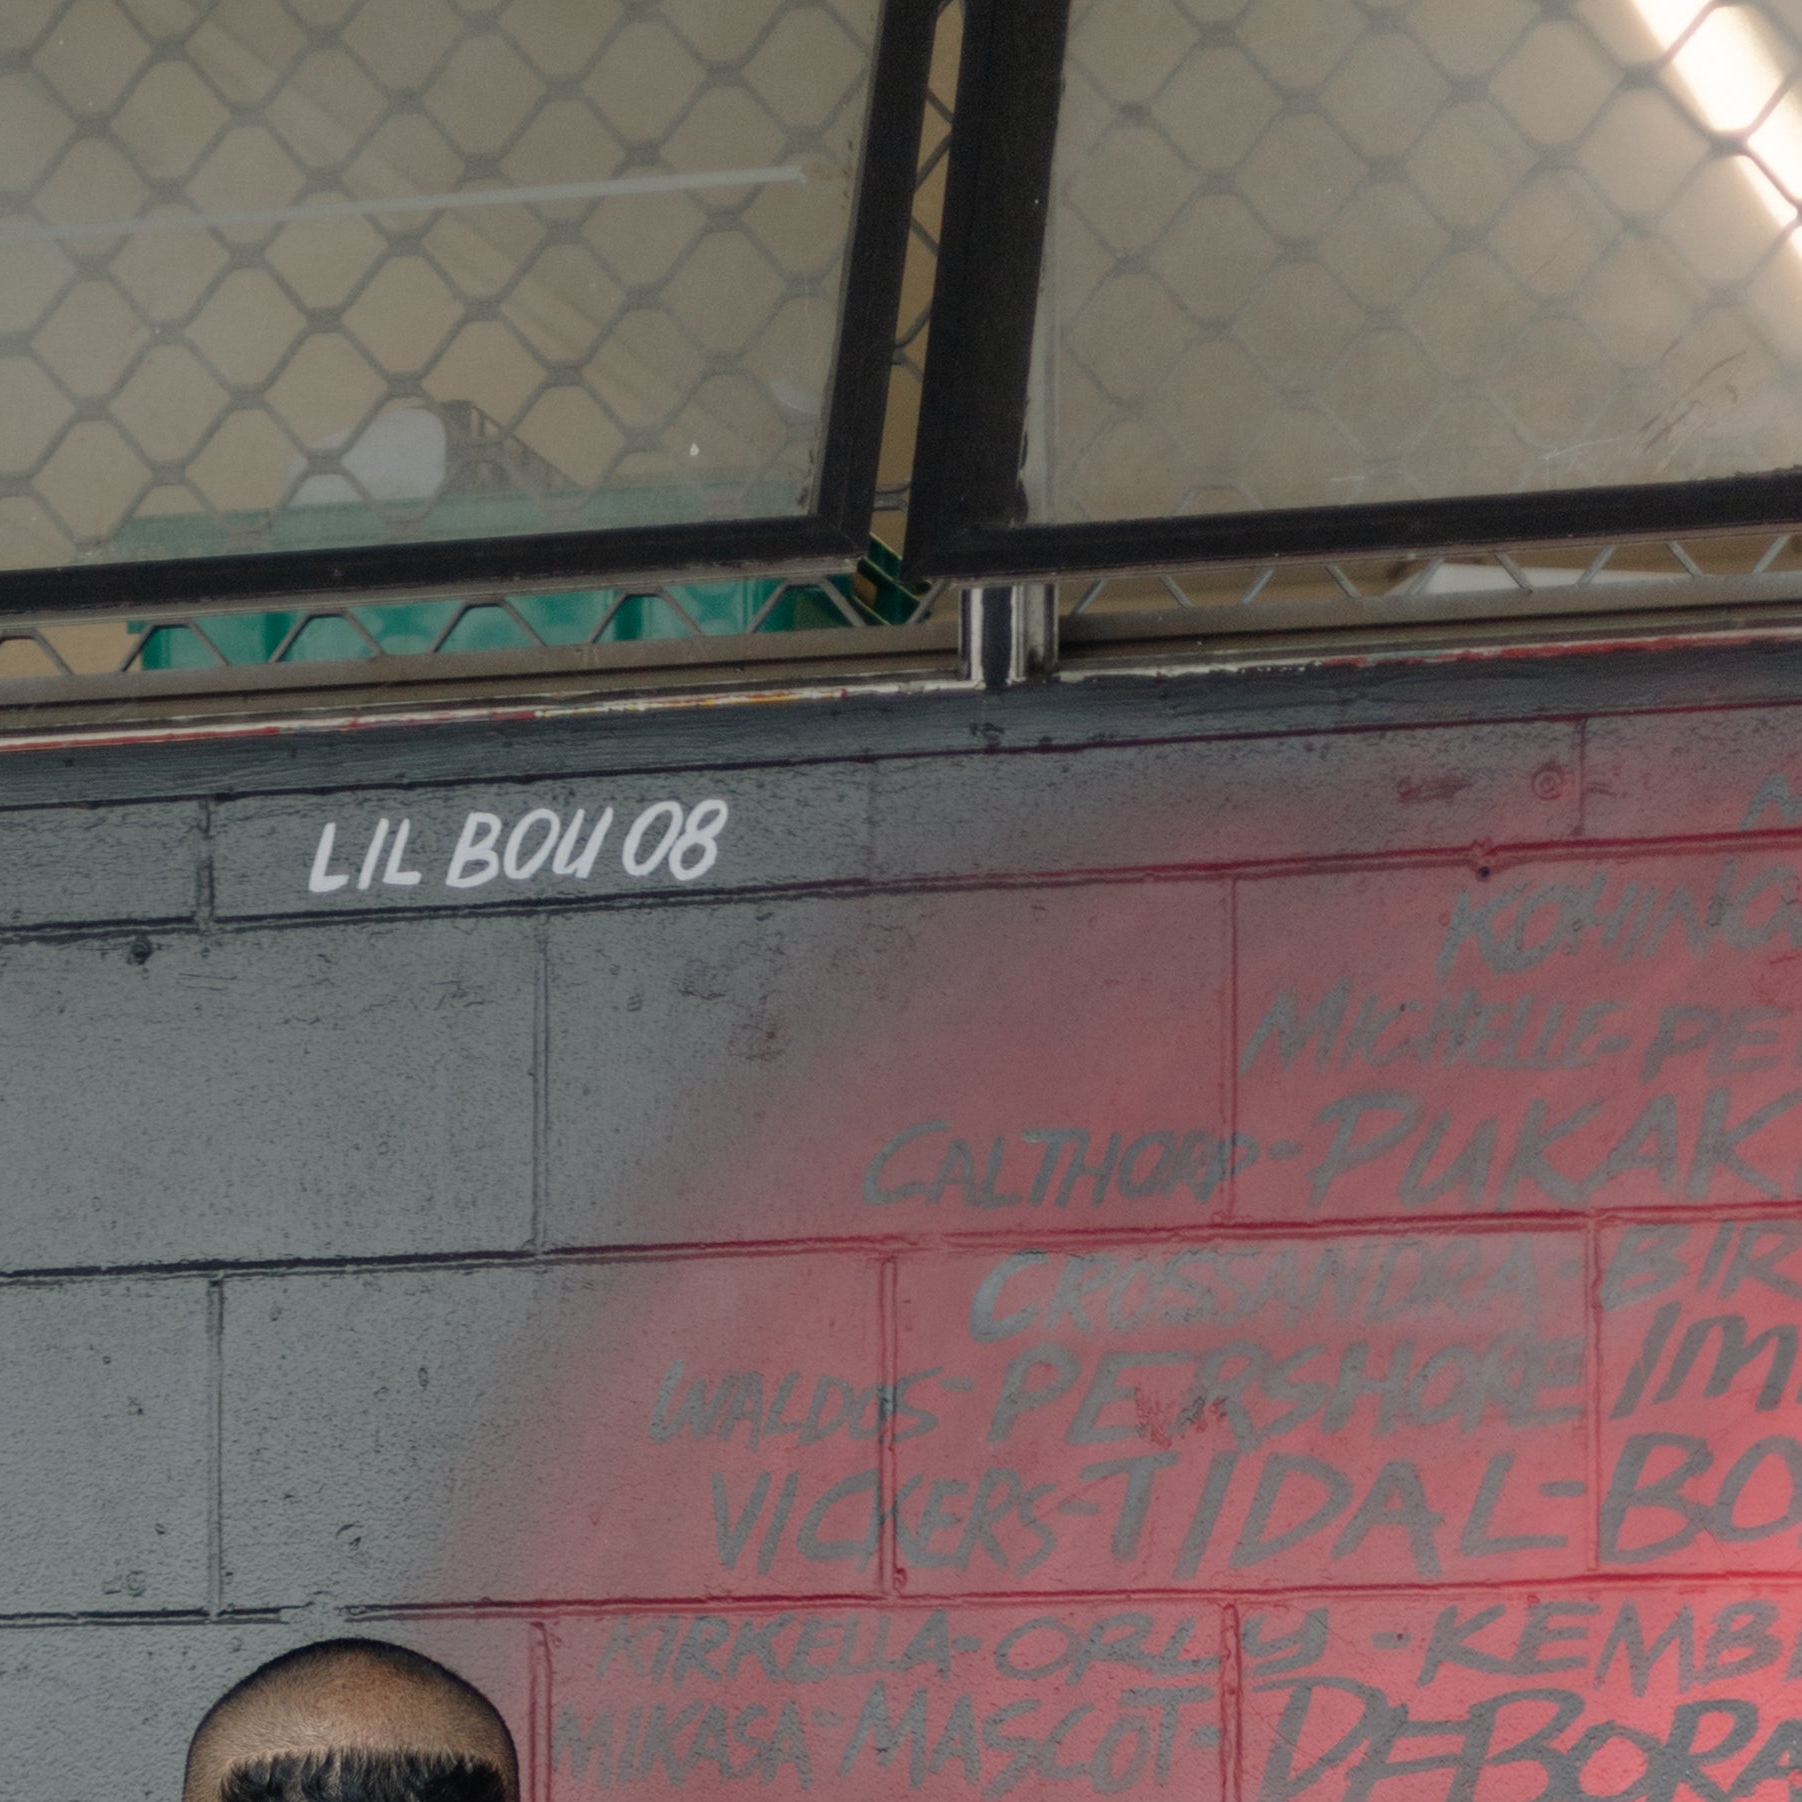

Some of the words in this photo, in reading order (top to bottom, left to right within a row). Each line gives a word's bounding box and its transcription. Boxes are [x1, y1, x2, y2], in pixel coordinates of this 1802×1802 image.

[309, 817, 422, 892] LIL
[622, 798, 729, 881] 08
[1434, 858, 1802, 984] KOHINO
[1638, 1002, 1802, 1086] PE
[1307, 1086, 1802, 1214] PUKAK
[1607, 1300, 1802, 1422] IM
